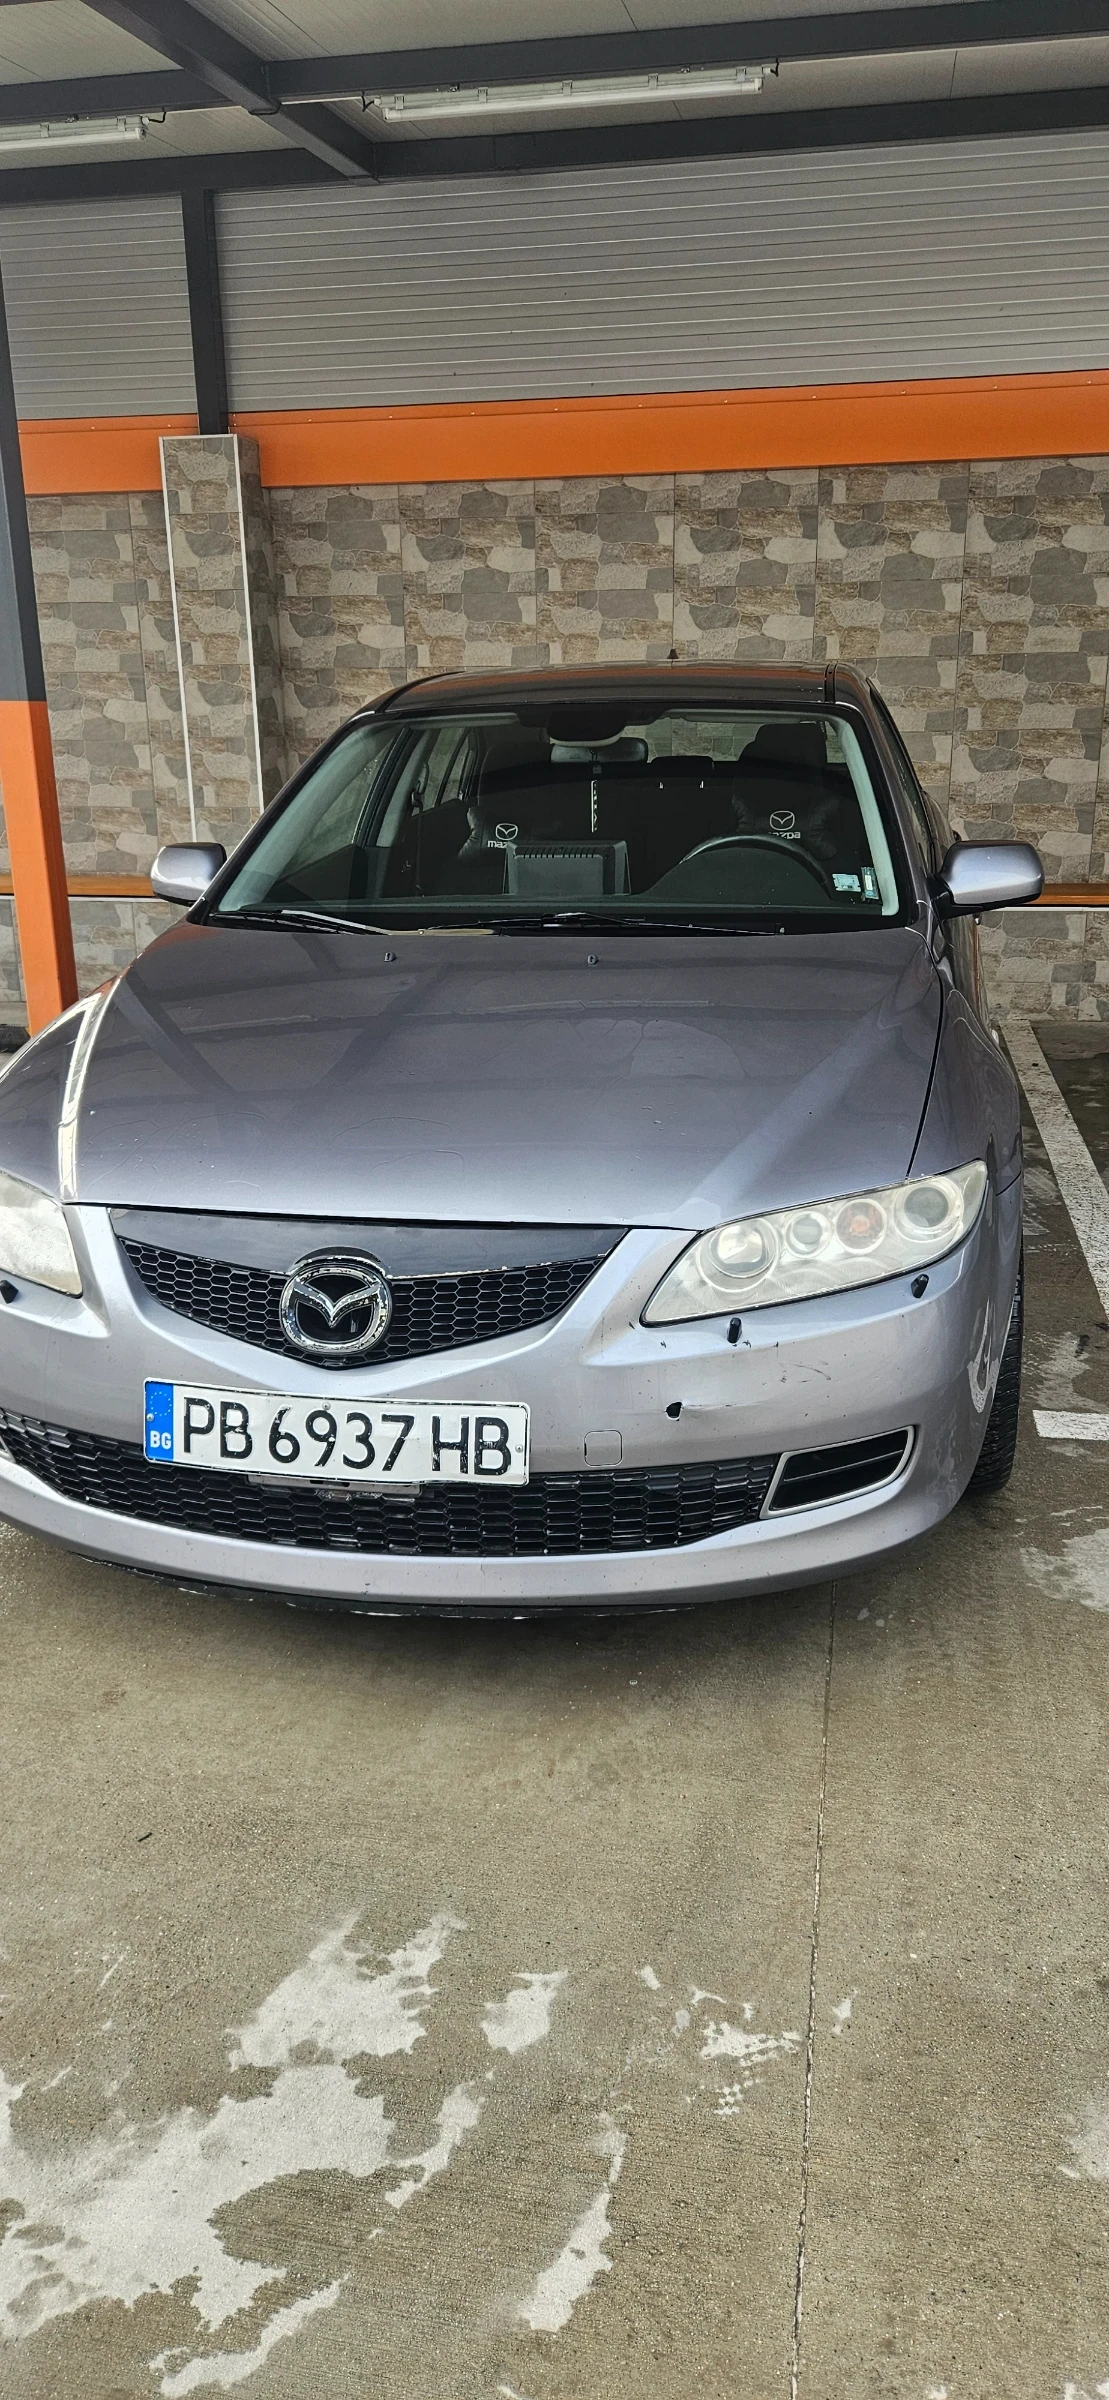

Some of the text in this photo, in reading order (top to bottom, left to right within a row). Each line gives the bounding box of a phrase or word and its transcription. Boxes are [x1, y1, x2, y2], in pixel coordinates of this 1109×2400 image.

[487, 840, 508, 849] maz
[150, 1430, 172, 1450] BG
[183, 1396, 512, 1476] PB 6937 HB
